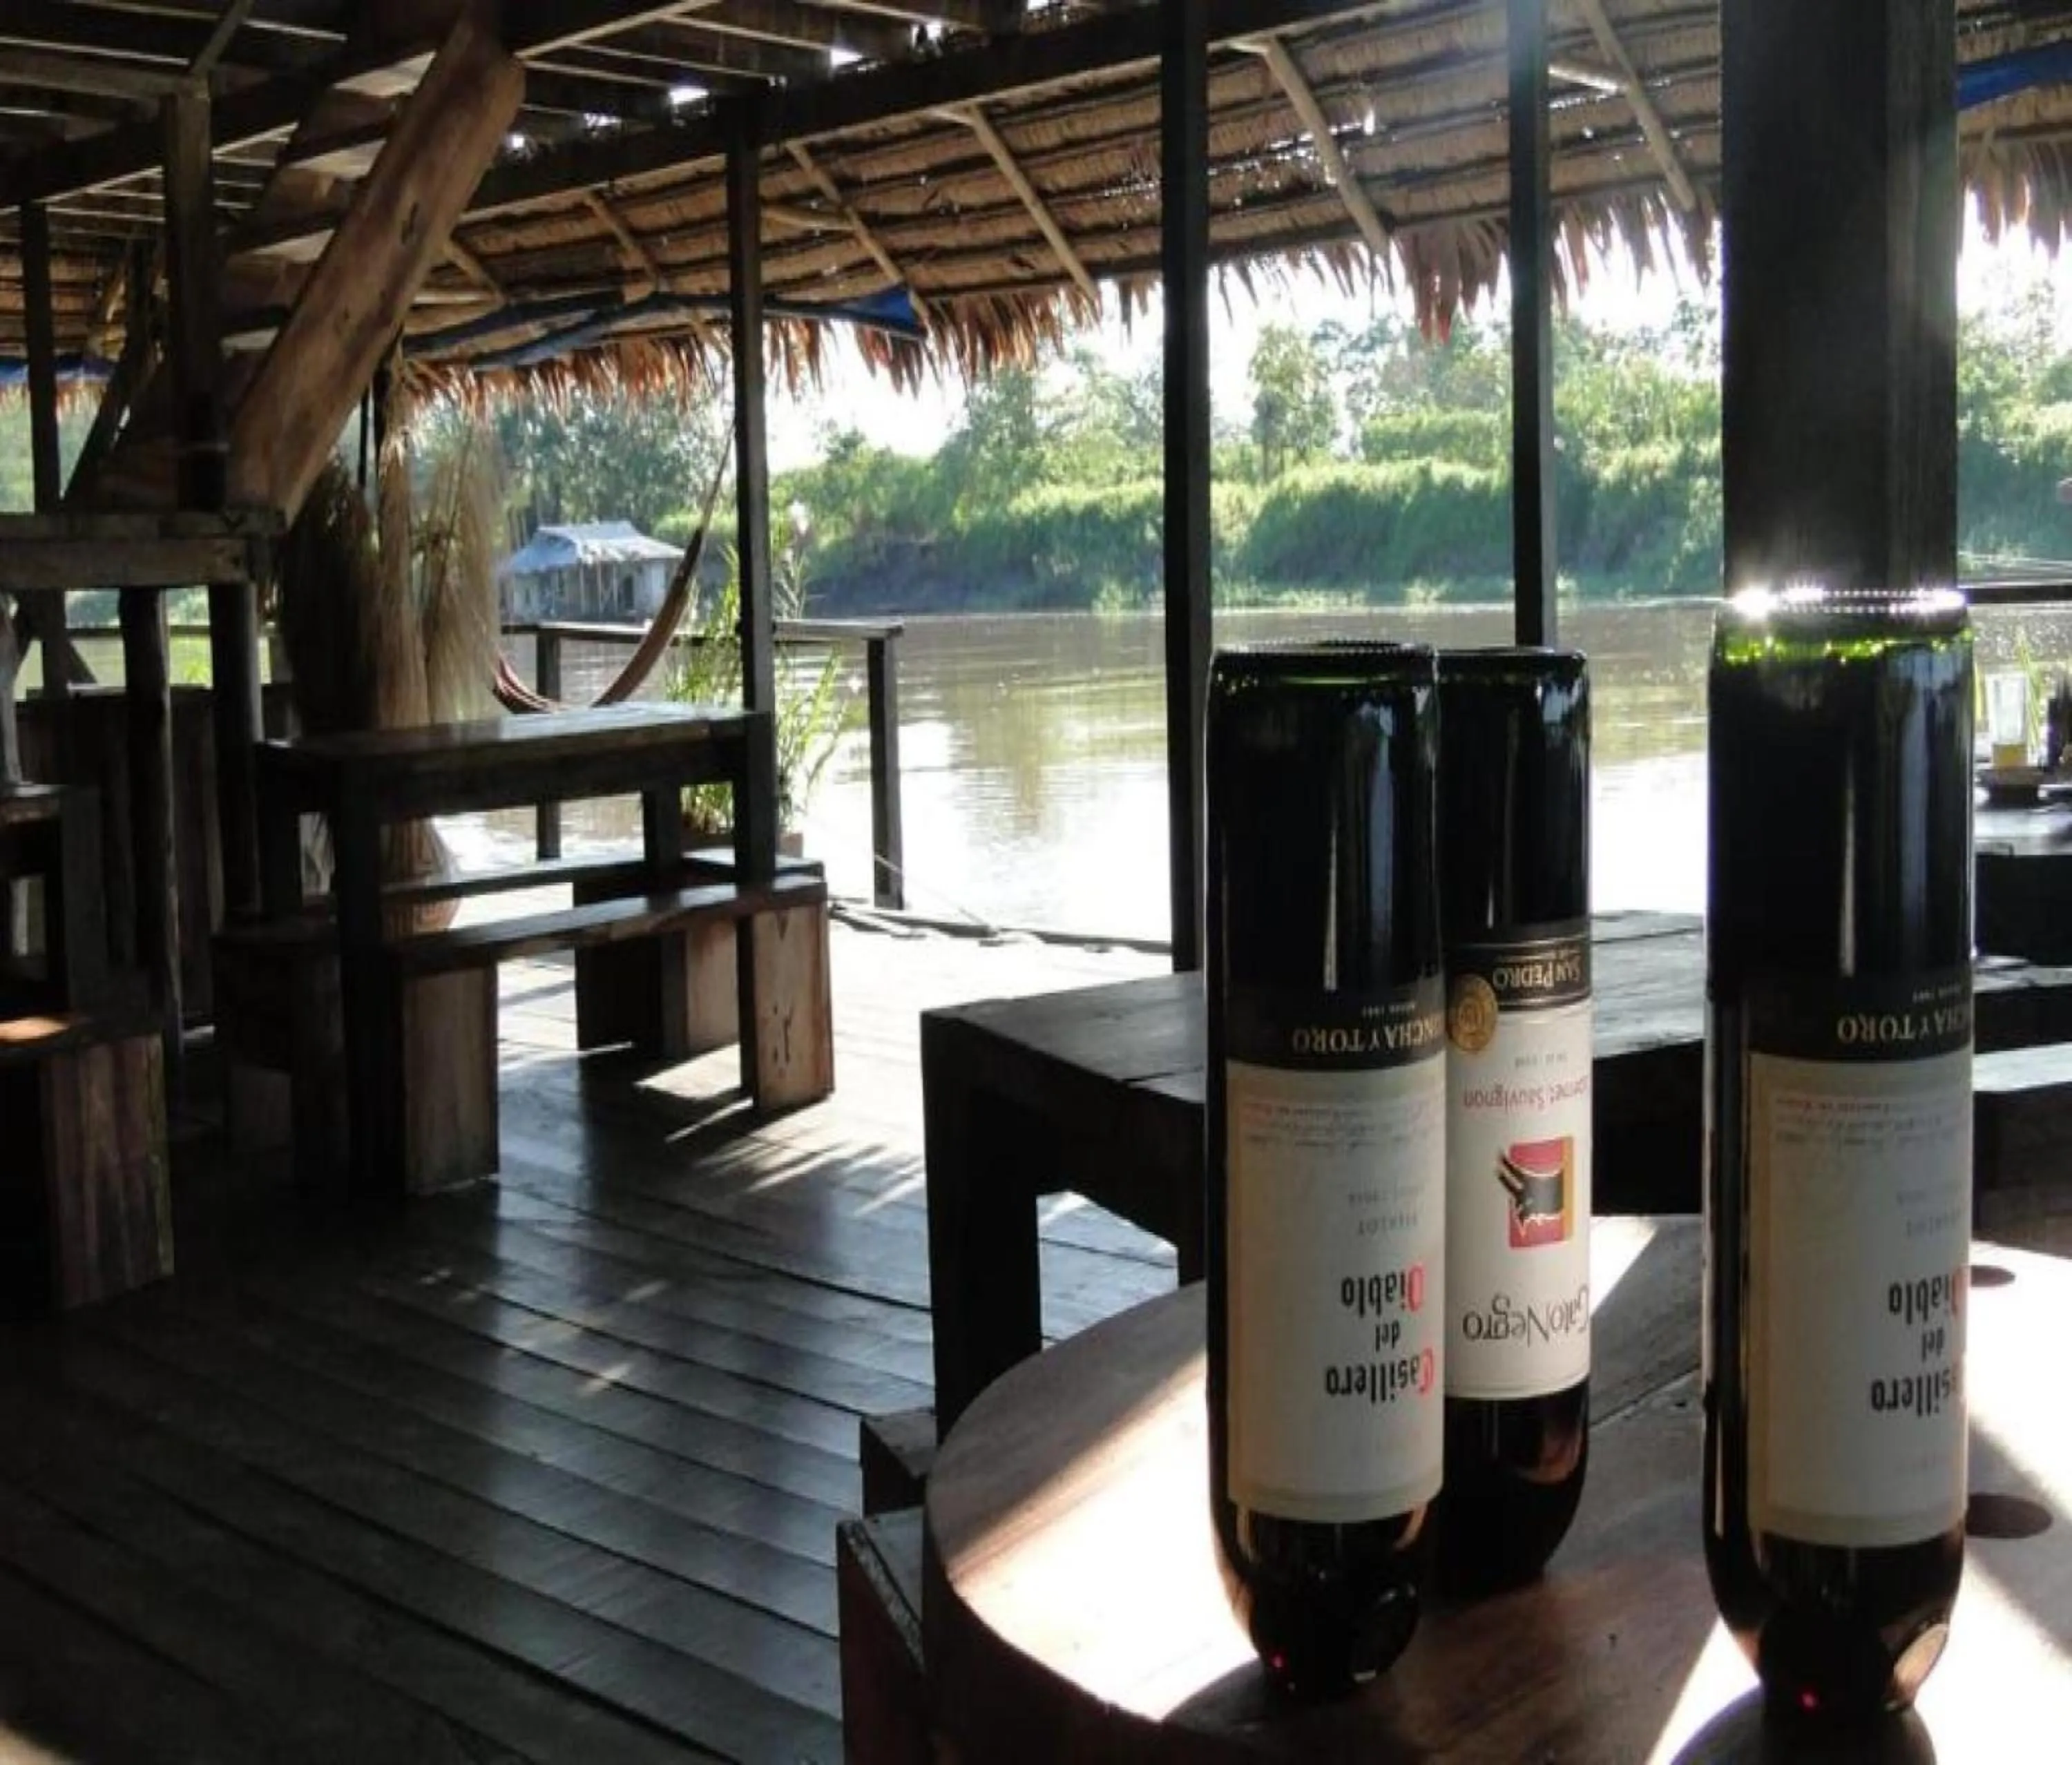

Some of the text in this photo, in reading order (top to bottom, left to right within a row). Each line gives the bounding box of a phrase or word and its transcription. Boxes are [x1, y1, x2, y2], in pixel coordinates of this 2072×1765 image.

[1492, 961, 1555, 990] PEDRO
[1292, 1028, 1367, 1054] TORO
[1836, 1014, 1916, 1044] TORO
[1463, 1082, 1546, 1112] Sauvignon
[1340, 1266, 1425, 1318] Diablo
[1374, 1319, 1401, 1353] del
[1921, 1326, 1944, 1363] del
[1325, 1347, 1435, 1405] Casillero
